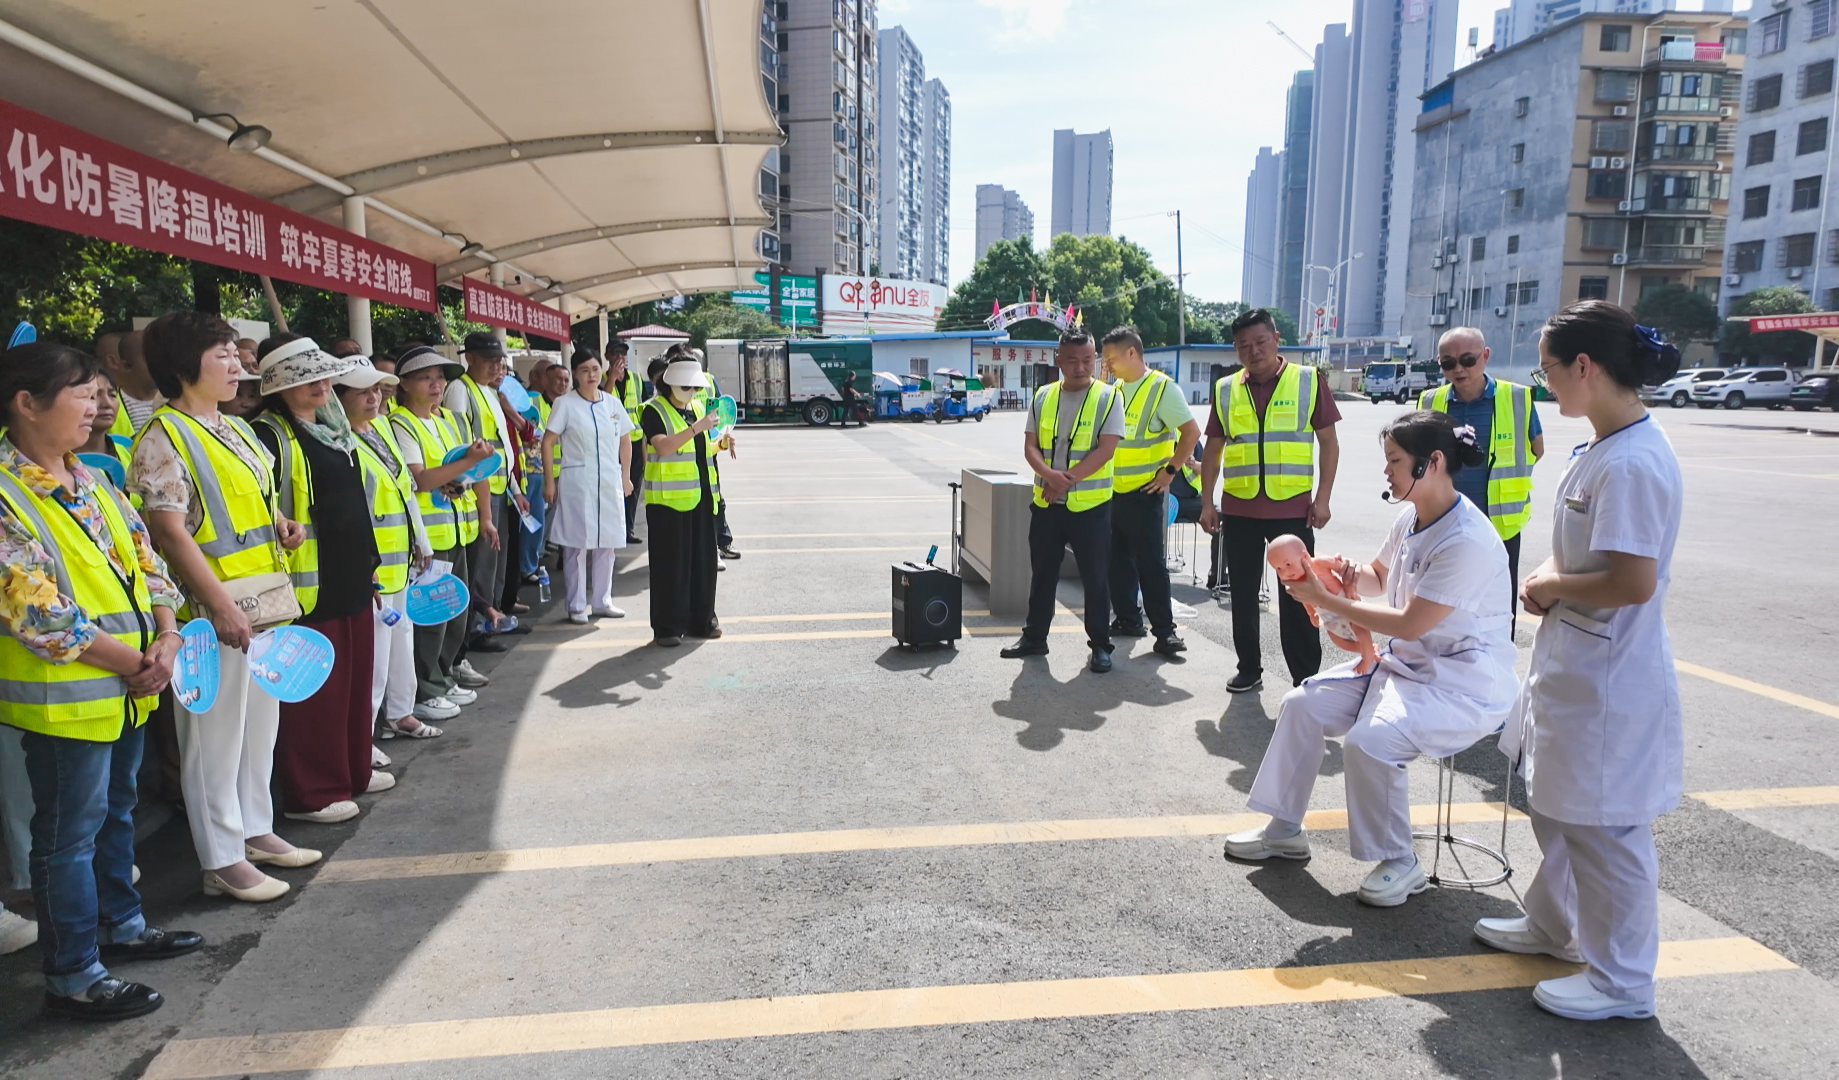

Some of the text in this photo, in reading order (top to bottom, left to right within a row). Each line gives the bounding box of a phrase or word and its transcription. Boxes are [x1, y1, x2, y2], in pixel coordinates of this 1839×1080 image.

[0, 128, 413, 298] 化防暑降温培训 筑牢夏季安全防线
[469, 287, 524, 325] 高温防范莫大意
[992, 348, 1047, 362] 服务至上
